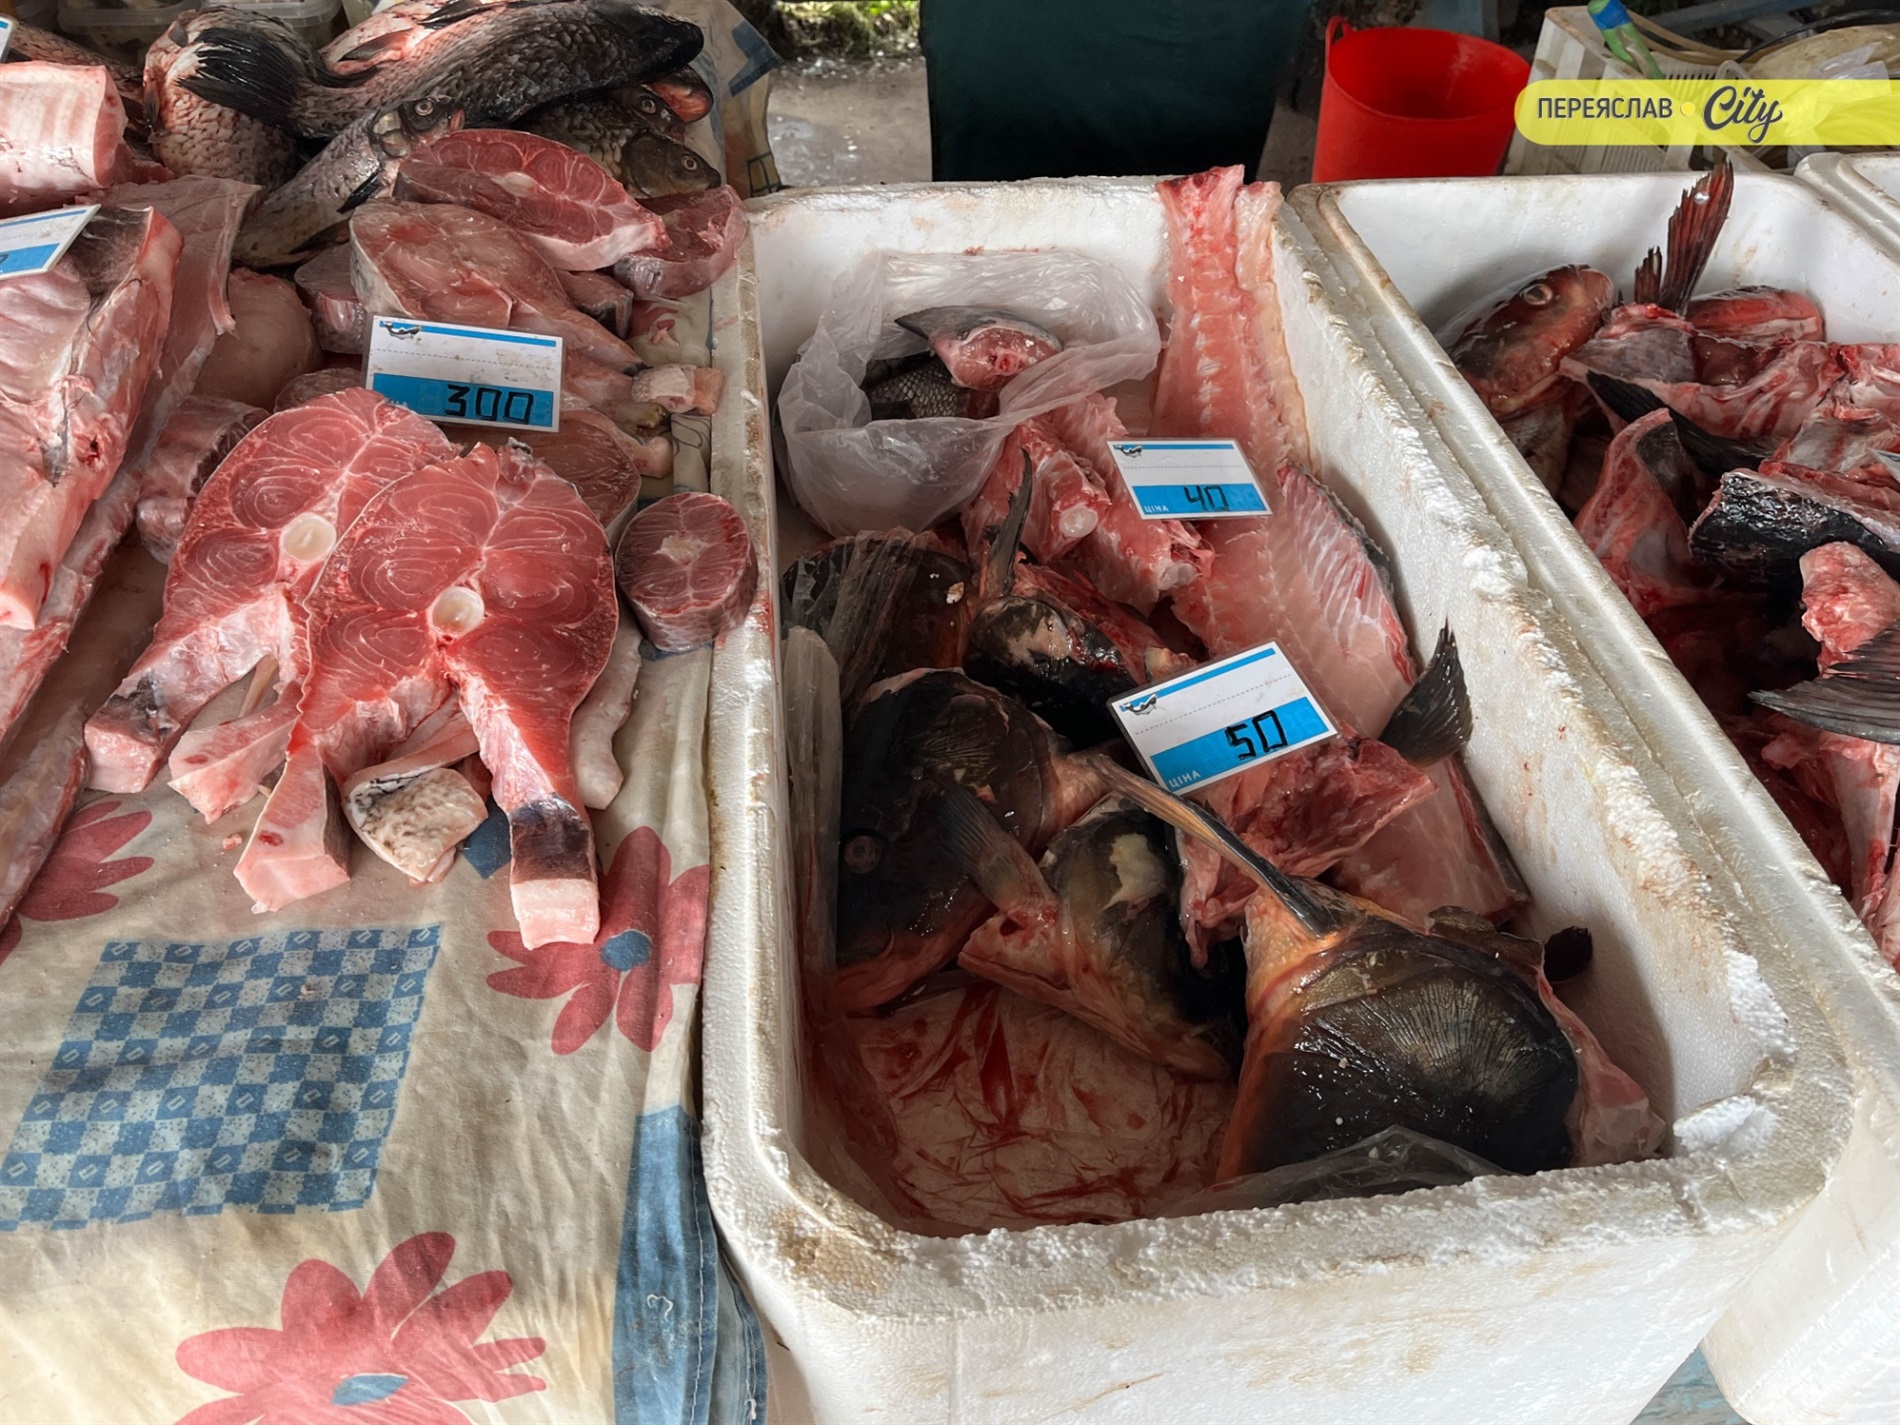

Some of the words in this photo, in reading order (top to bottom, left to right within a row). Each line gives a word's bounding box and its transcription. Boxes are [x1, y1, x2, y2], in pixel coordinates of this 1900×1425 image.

[445, 384, 534, 425] 300
[1143, 505, 1169, 514] ЦІНА
[1183, 485, 1230, 512] 40
[1168, 770, 1201, 789] ЦІНА
[1224, 709, 1289, 761] 50
